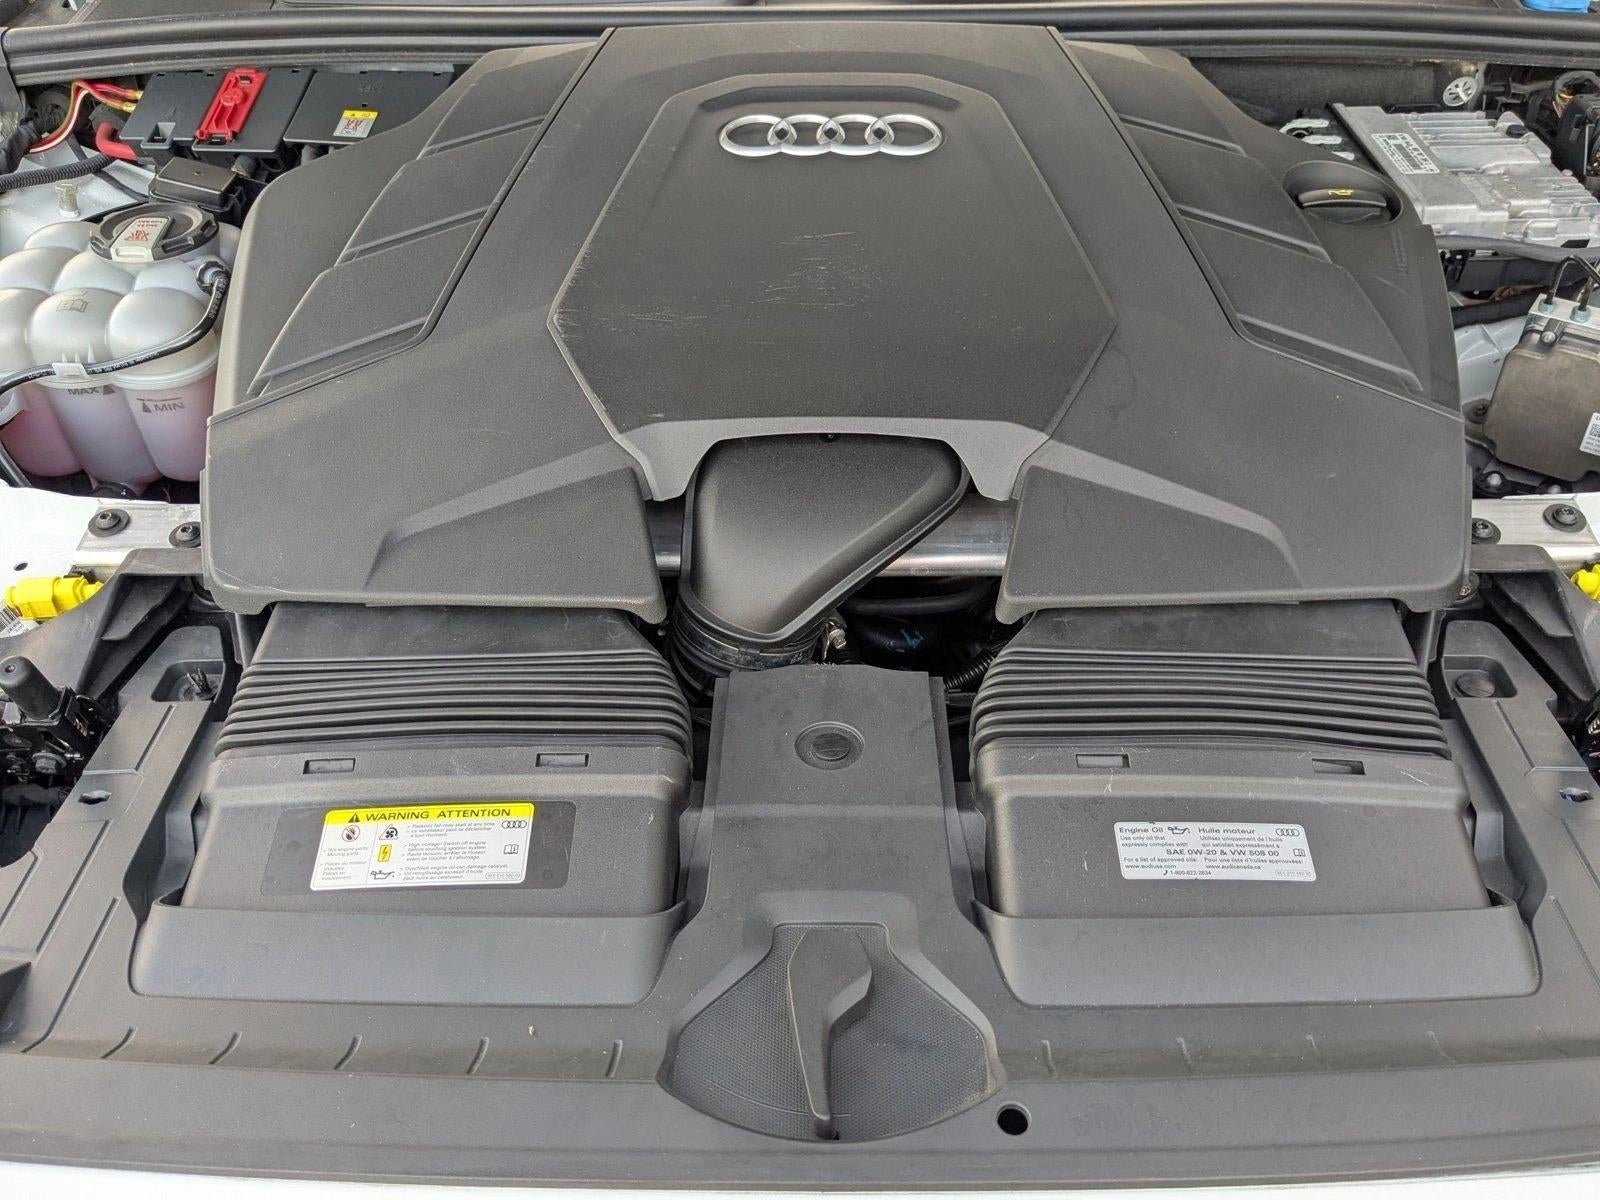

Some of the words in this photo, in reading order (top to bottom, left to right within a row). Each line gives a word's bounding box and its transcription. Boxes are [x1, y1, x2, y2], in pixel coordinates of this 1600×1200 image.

[67, 387, 99, 395] MAX
[154, 402, 185, 412] MIN
[366, 811, 429, 820] WARNING
[437, 808, 511, 818] ATTENTION
